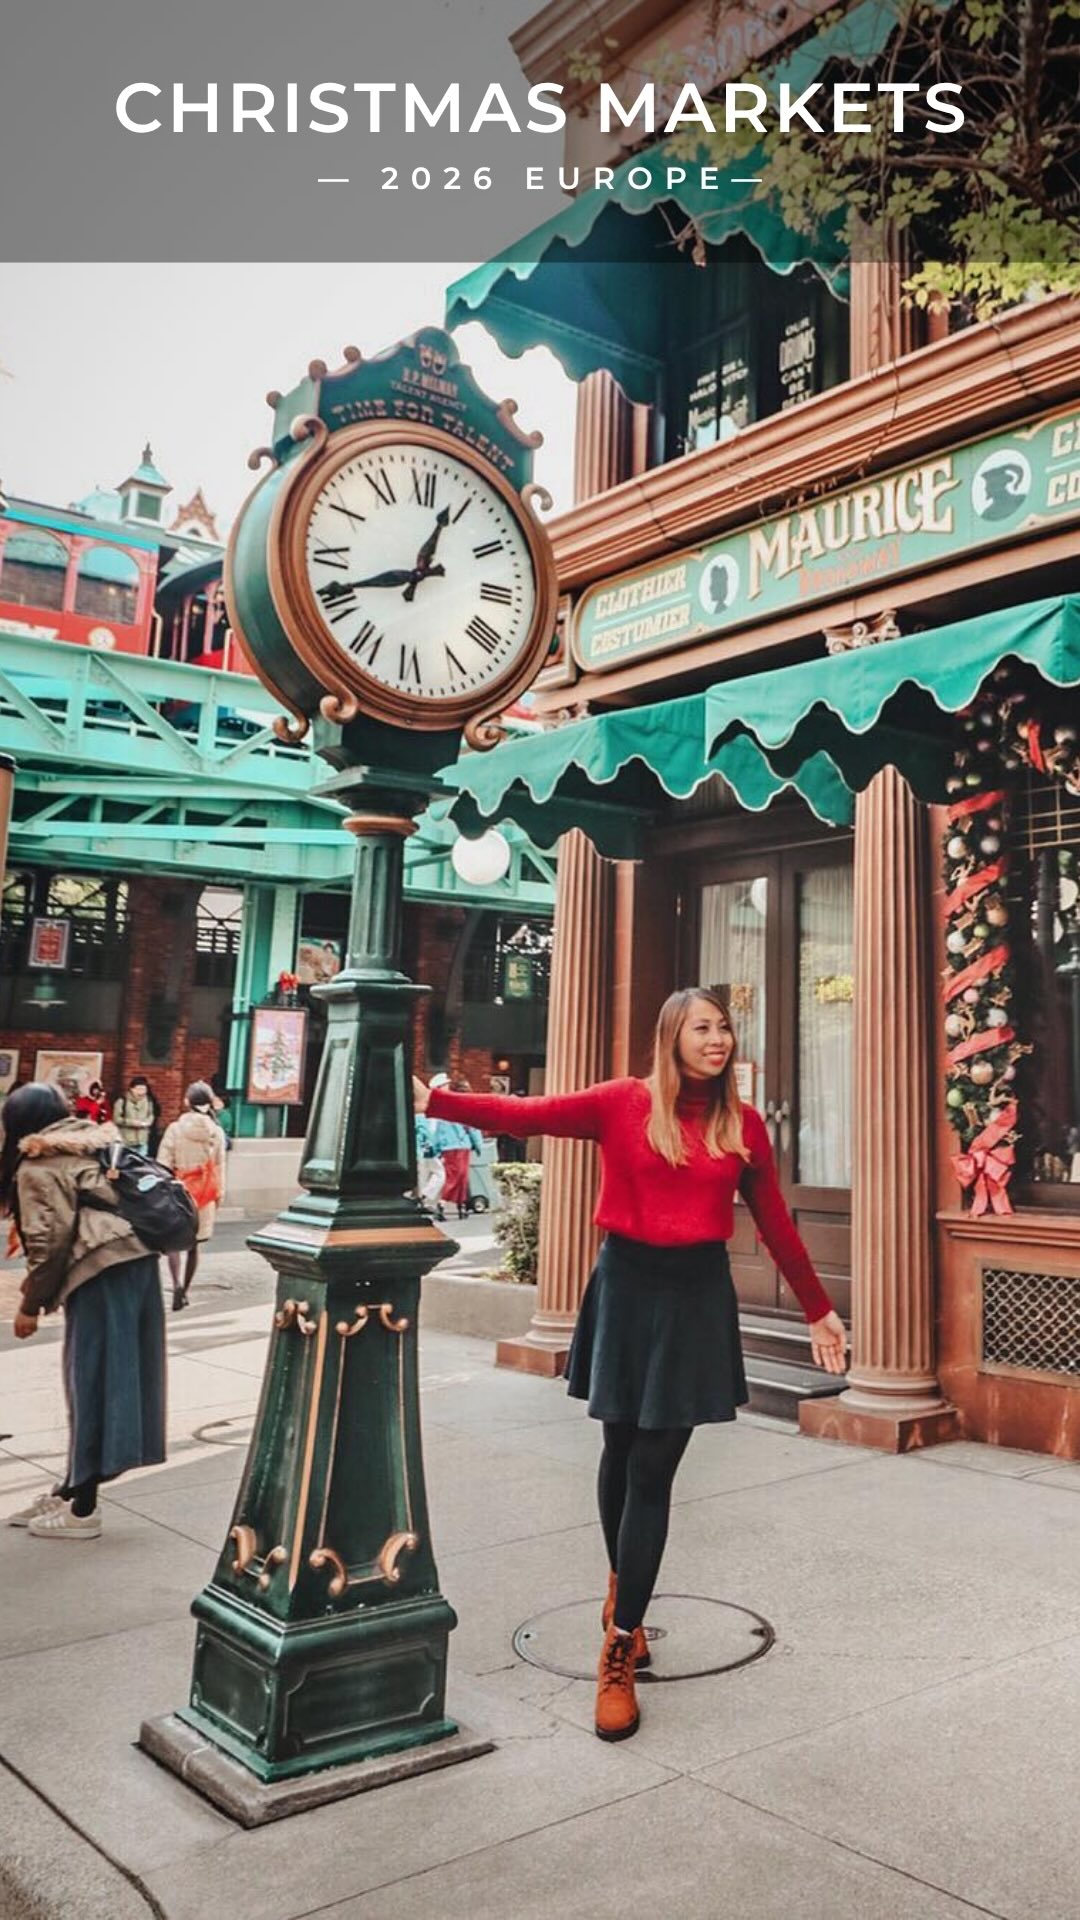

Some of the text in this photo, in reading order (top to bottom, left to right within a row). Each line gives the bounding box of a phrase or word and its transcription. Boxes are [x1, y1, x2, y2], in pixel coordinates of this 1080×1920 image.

[331, 399, 516, 471] TIME FOR TALENT
[364, 468, 397, 511] XI
[409, 467, 437, 510] XII
[329, 491, 367, 533] X
[452, 497, 472, 524] I
[747, 456, 962, 601] MAURICE
[472, 539, 504, 559] II
[480, 582, 513, 606] III
[595, 564, 687, 621] CLOTHIER
[349, 620, 384, 666] VII
[464, 615, 502, 654] IIII
[399, 643, 422, 684] VI
[444, 641, 468, 681] V
